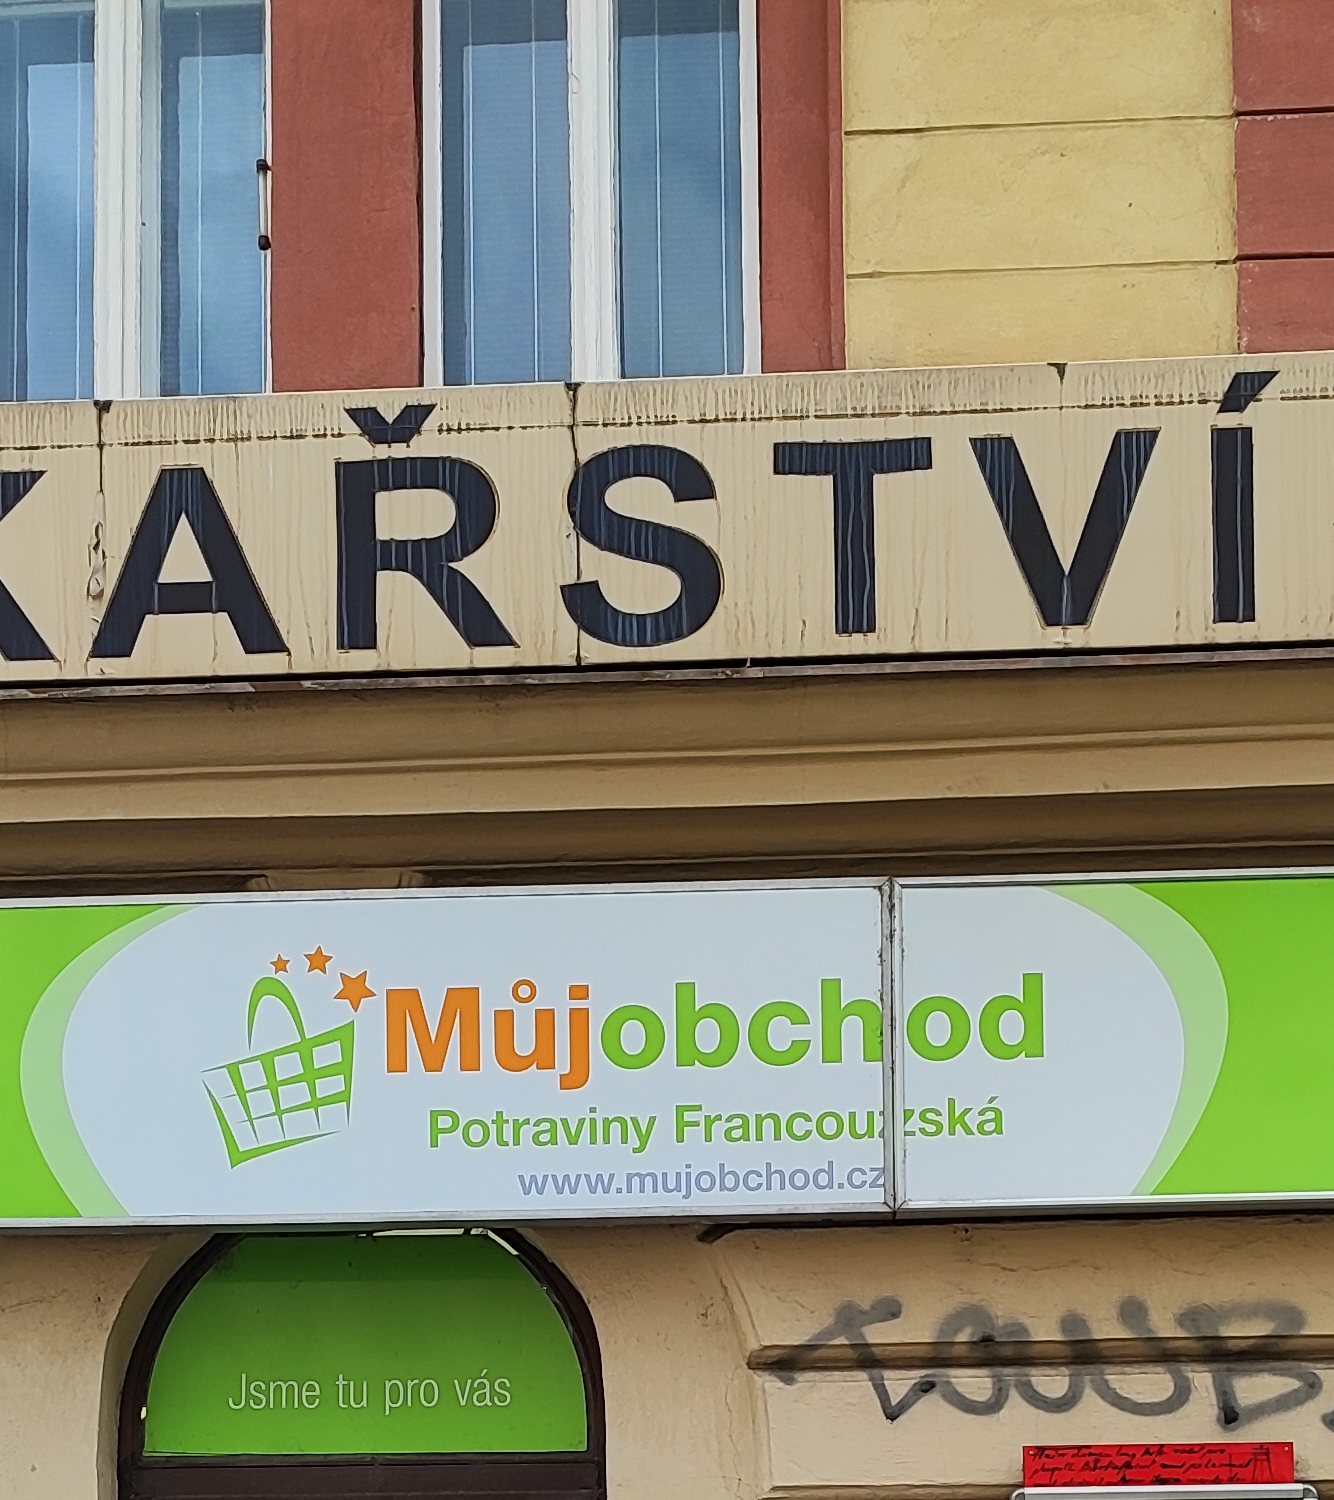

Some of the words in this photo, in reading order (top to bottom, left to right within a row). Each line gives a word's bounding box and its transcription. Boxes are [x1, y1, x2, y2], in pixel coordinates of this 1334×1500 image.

[385, 972, 1045, 1090] Můjobchod
[428, 1106, 657, 1155] Potraviny
[518, 1161, 885, 1200] www.mujobchod.cz
[228, 1372, 321, 1410] Jsme
[335, 1373, 368, 1409] tu
[383, 1376, 440, 1416] pro
[453, 1368, 512, 1407] vás
